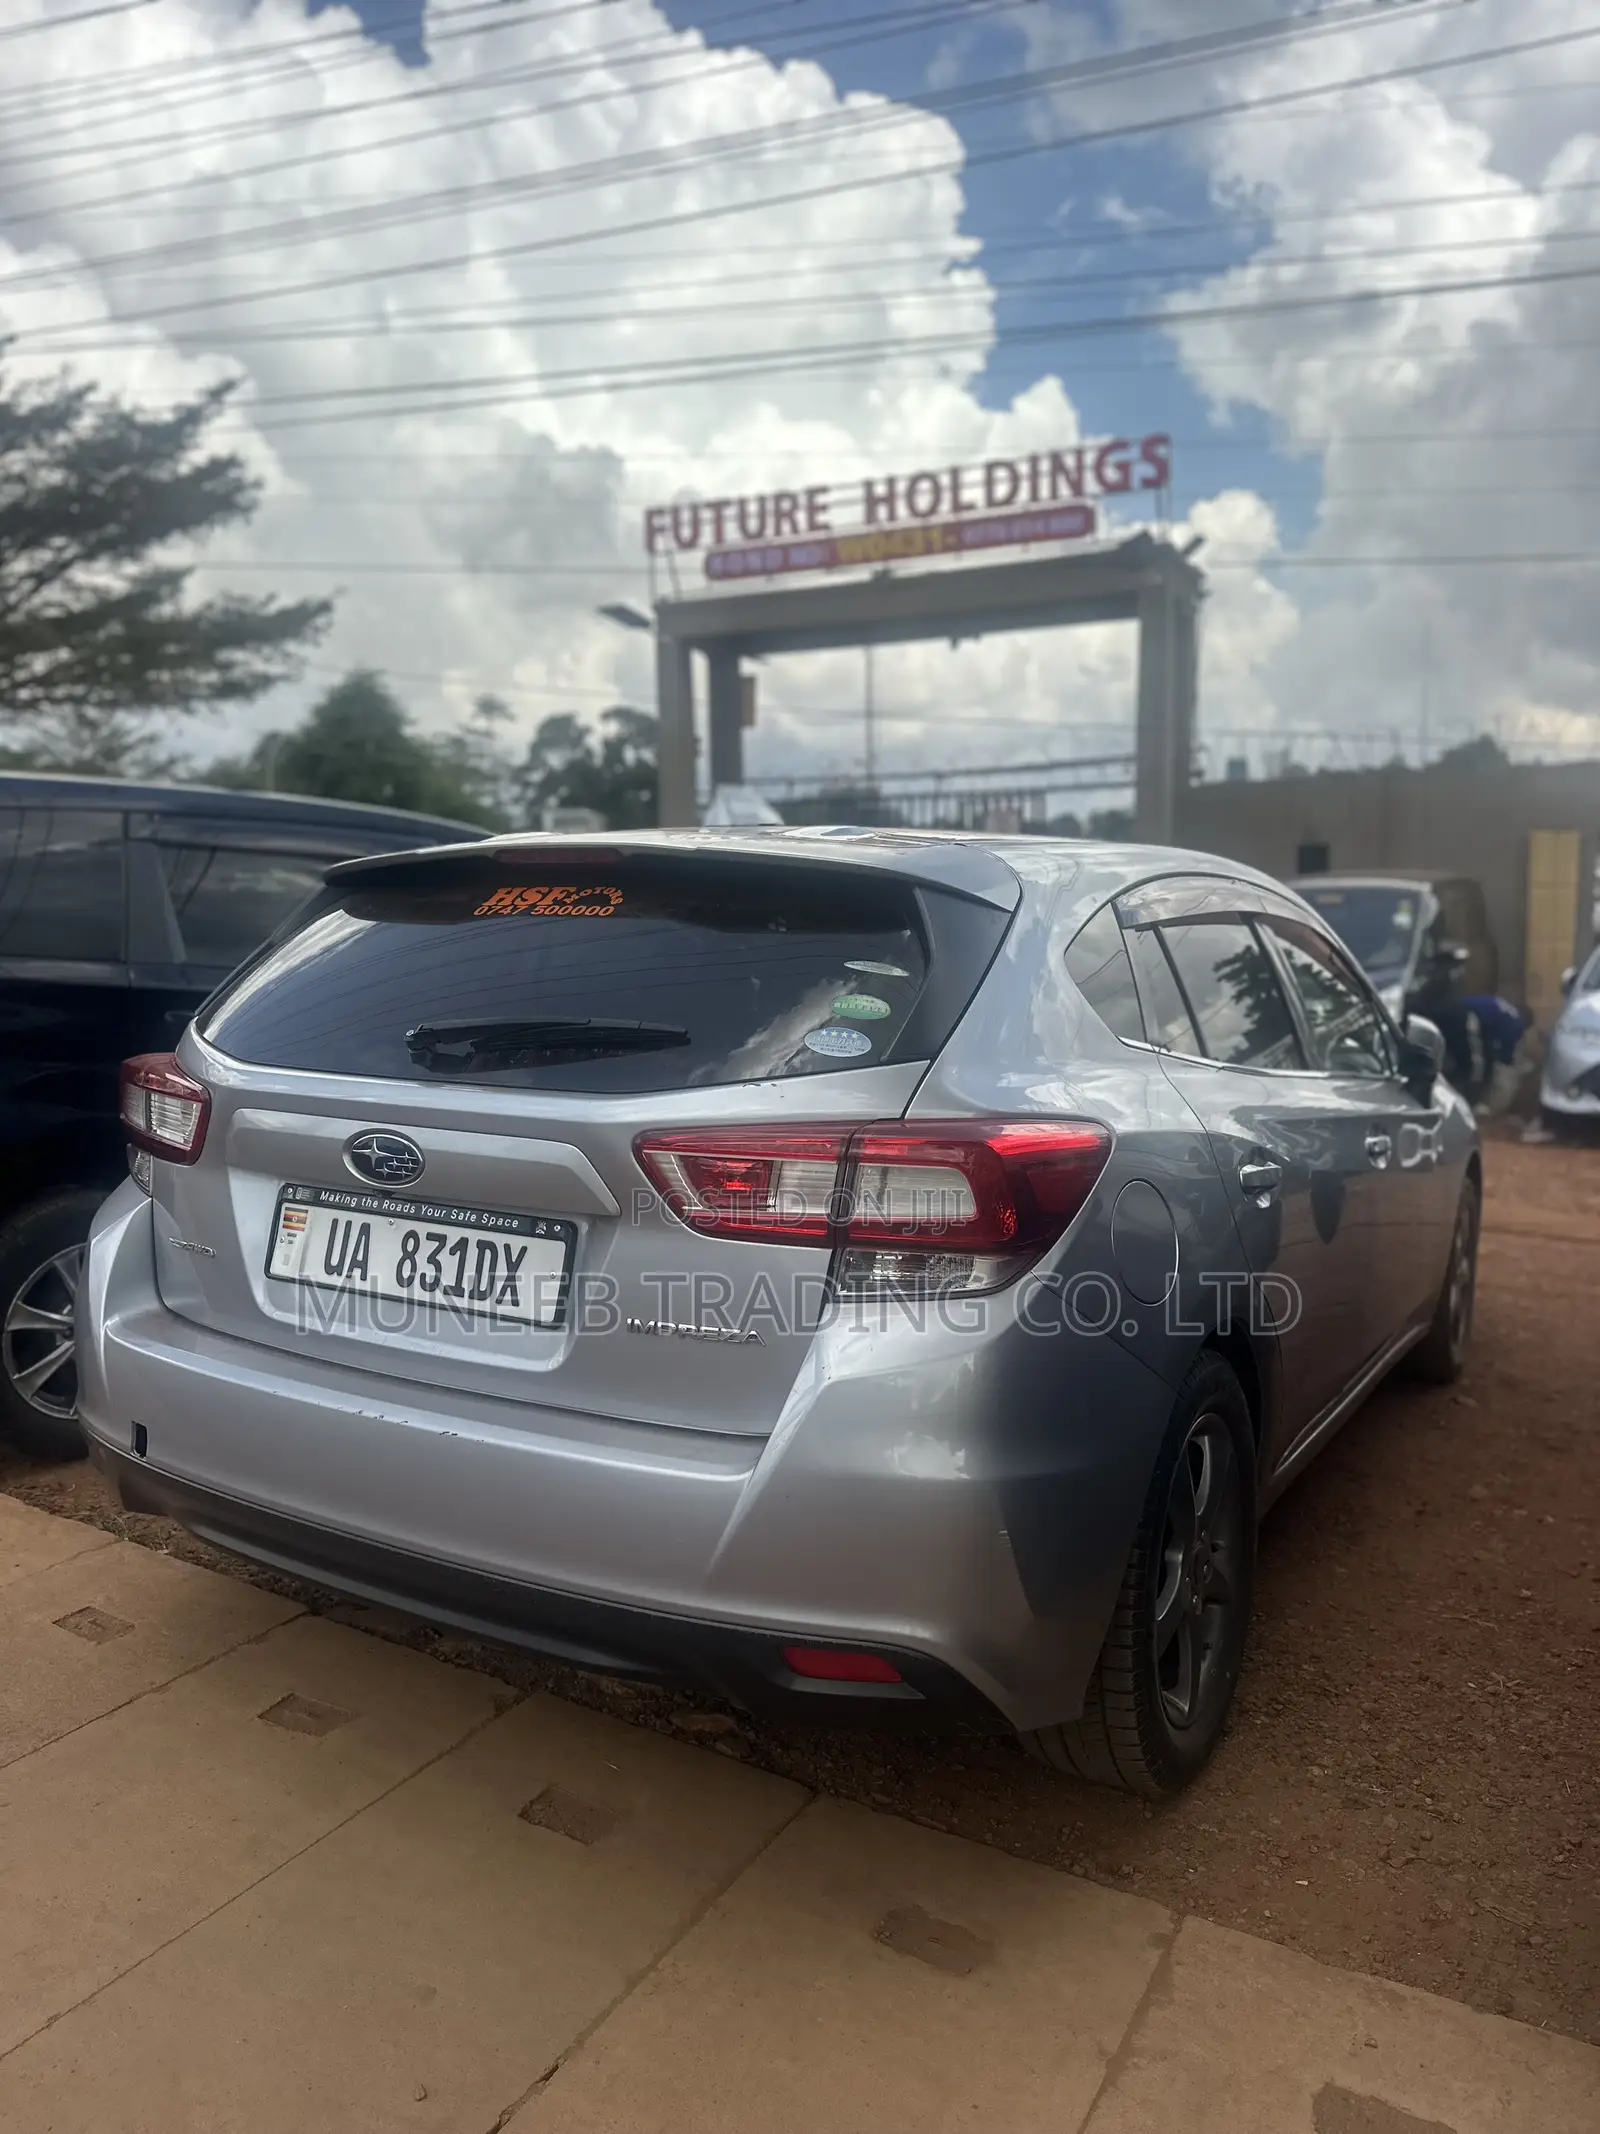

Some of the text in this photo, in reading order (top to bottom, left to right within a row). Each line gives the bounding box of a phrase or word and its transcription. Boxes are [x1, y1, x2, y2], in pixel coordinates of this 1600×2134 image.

[644, 433, 1171, 557] FUTURE HOLDINGS
[473, 905, 616, 917] 0747 500000
[481, 886, 578, 906] HSF
[319, 1190, 519, 1229] Making the Roads Your Safe Space
[323, 1217, 528, 1307] UA 831DX
[626, 1317, 766, 1348] IMPREZA
